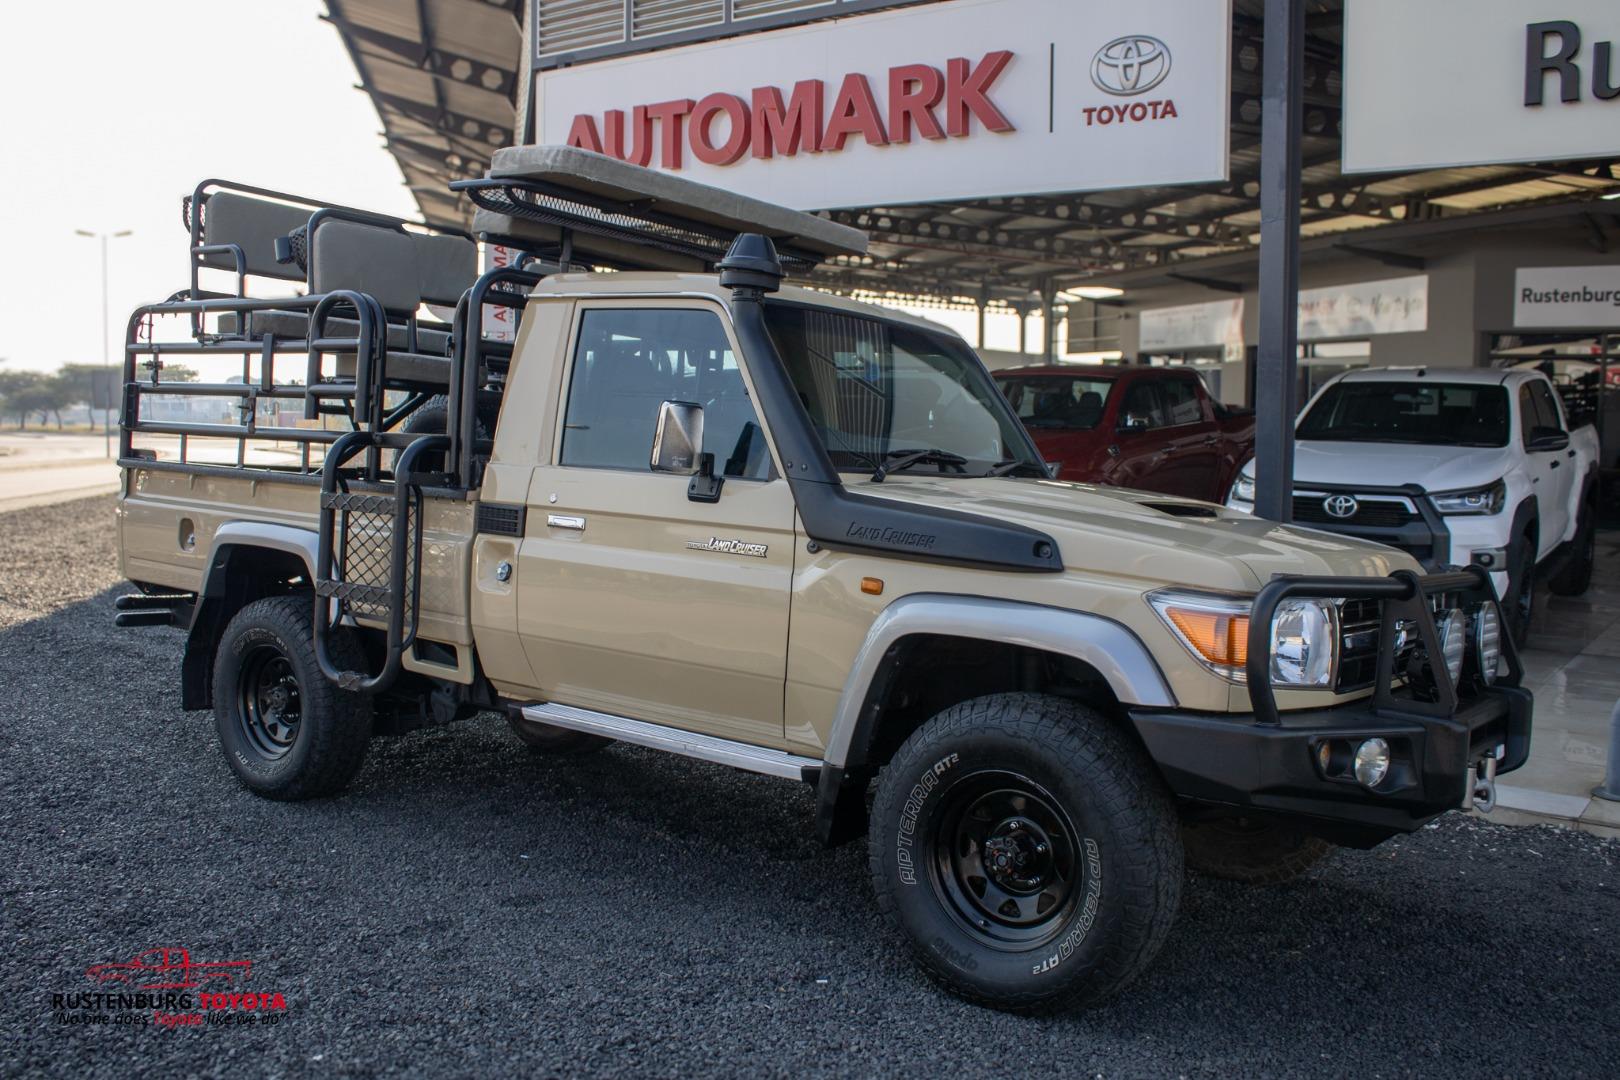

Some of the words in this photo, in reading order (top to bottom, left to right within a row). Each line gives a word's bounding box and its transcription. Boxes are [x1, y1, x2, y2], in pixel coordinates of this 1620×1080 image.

[566, 50, 1016, 170] AUTOMARK
[1082, 99, 1178, 126] TOYOTA
[1521, 285, 1620, 307] Rustenburg
[708, 537, 731, 552] LAND
[730, 540, 768, 558] CRUISER
[846, 521, 881, 540] LAND
[880, 527, 937, 548] CRUISER
[897, 769, 940, 885] APTERRA
[933, 752, 960, 776] AT2
[1059, 838, 1101, 961] APTERRA
[1032, 953, 1060, 975] AT2
